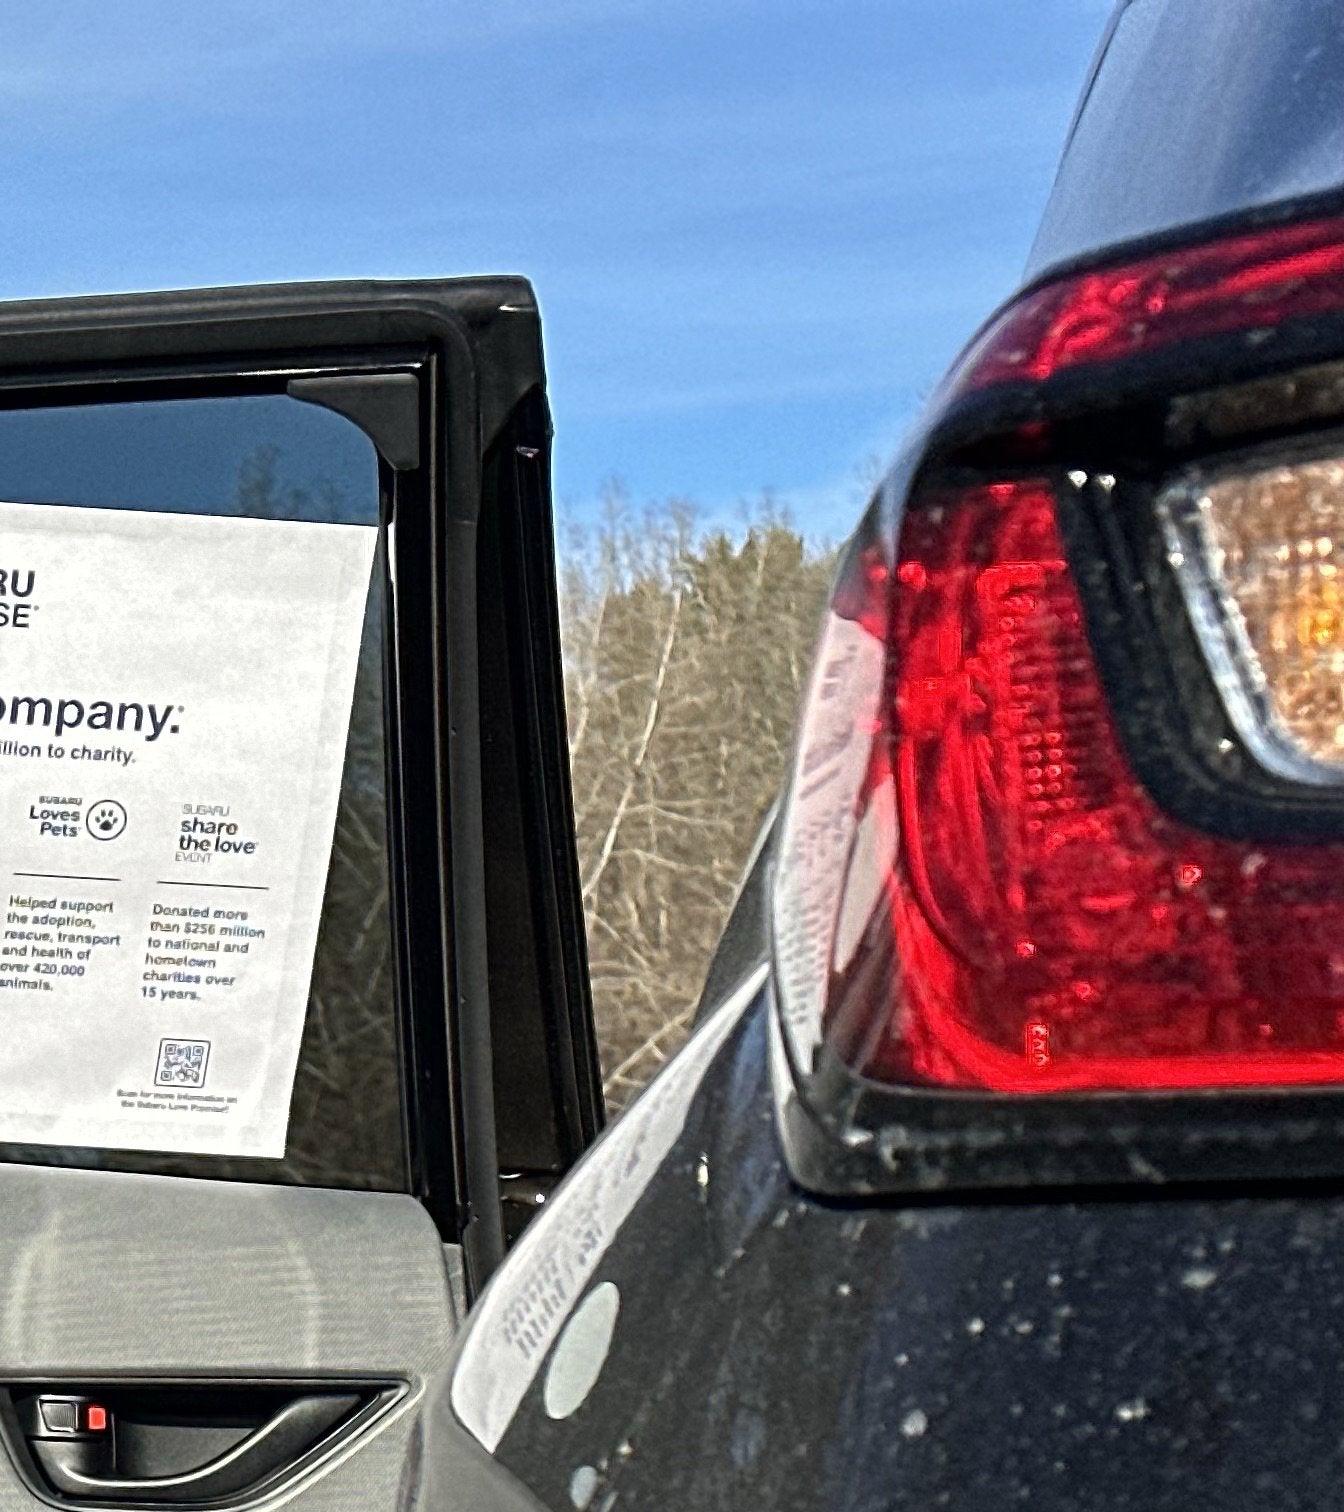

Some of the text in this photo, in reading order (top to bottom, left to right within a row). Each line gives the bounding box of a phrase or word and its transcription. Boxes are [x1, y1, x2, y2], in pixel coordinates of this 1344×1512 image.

[48, 744, 65, 759] to
[71, 745, 136, 767] charity.
[30, 805, 80, 822] Loves
[40, 822, 78, 838] Pets
[181, 817, 238, 835] share
[179, 834, 256, 854] the love
[9, 895, 114, 913] Helped support
[152, 904, 248, 921] Donated more
[7, 912, 96, 930] the adoption,
[150, 921, 180, 934] than
[220, 926, 265, 938] million
[4, 930, 120, 947] rescue, transport
[148, 937, 249, 954] to national and
[2, 946, 91, 961] and health of
[145, 954, 216, 968] hometown
[0, 963, 84, 976] over 420,000
[142, 970, 236, 986] charities over
[142, 986, 201, 1001] 15 years.
